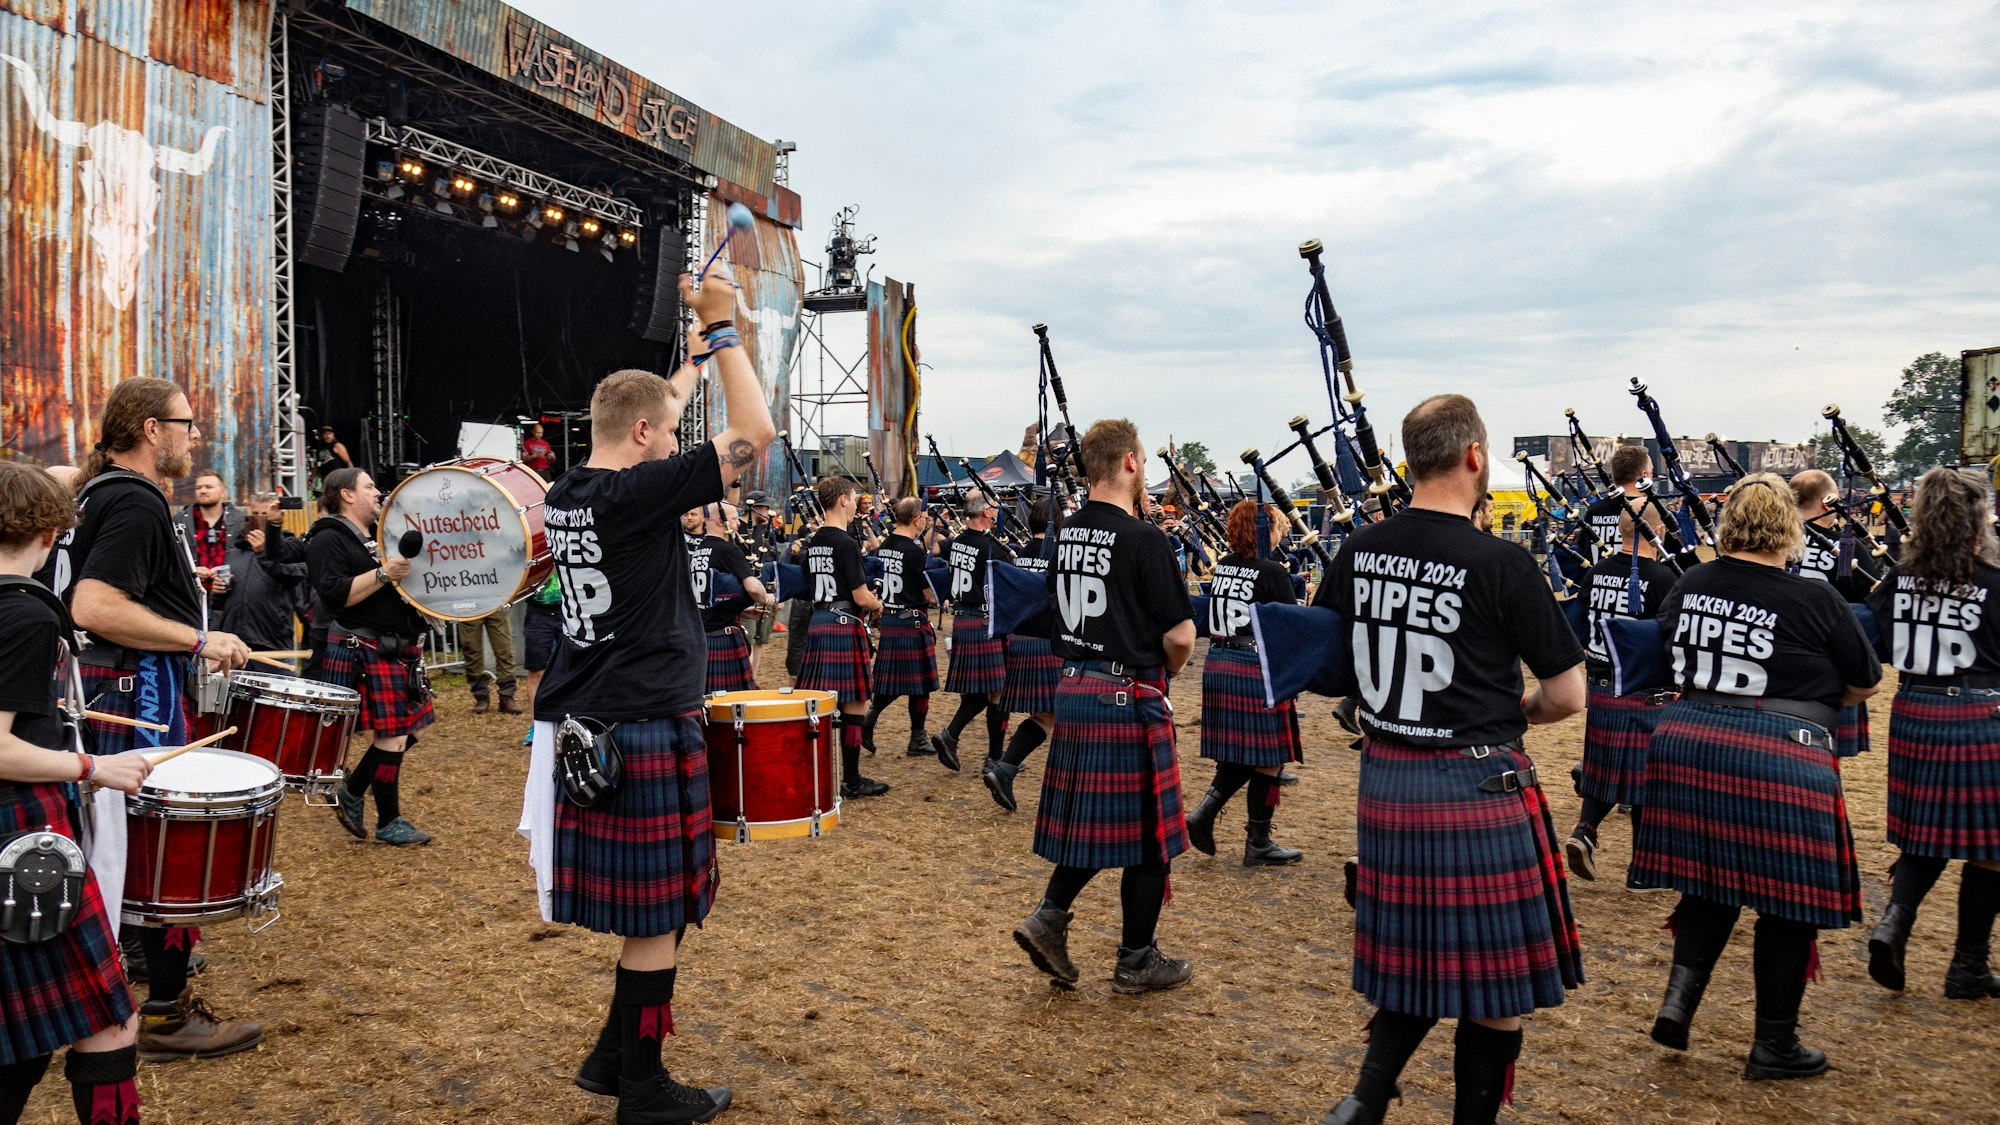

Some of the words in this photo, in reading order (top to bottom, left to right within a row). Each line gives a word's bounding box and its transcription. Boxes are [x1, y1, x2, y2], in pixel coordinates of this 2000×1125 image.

[635, 97, 698, 149] STAGE
[403, 507, 501, 535] Nutscheid
[1059, 527, 1090, 542] WACKEN
[1090, 529, 1116, 546] 2024
[1591, 525, 1622, 543] PIPE
[1592, 515, 1619, 524] WACKEN
[1032, 558, 1049, 568] 2024
[1057, 544, 1111, 576] PIPES
[1215, 564, 1240, 576] WACKEN
[1238, 567, 1260, 580] 2024
[1353, 551, 1420, 580] WACKEN
[1420, 561, 1467, 590] 2024
[423, 571, 457, 594] Pipe
[459, 567, 499, 587] Band
[1211, 576, 1254, 600] PIPES
[1593, 574, 1624, 588] WACKEN
[1623, 577, 1649, 592] 224
[1056, 573, 1107, 635] UP
[1208, 597, 1251, 637] UP
[1353, 577, 1463, 633] PIPES
[1682, 593, 1734, 617] WACKEN
[1734, 604, 1778, 630] 2024
[1893, 593, 1982, 631] PIPES
[1673, 613, 1775, 659] PIPES
[1892, 622, 1977, 676] UP
[1352, 621, 1455, 721] UP
[1671, 646, 1768, 697] UP
